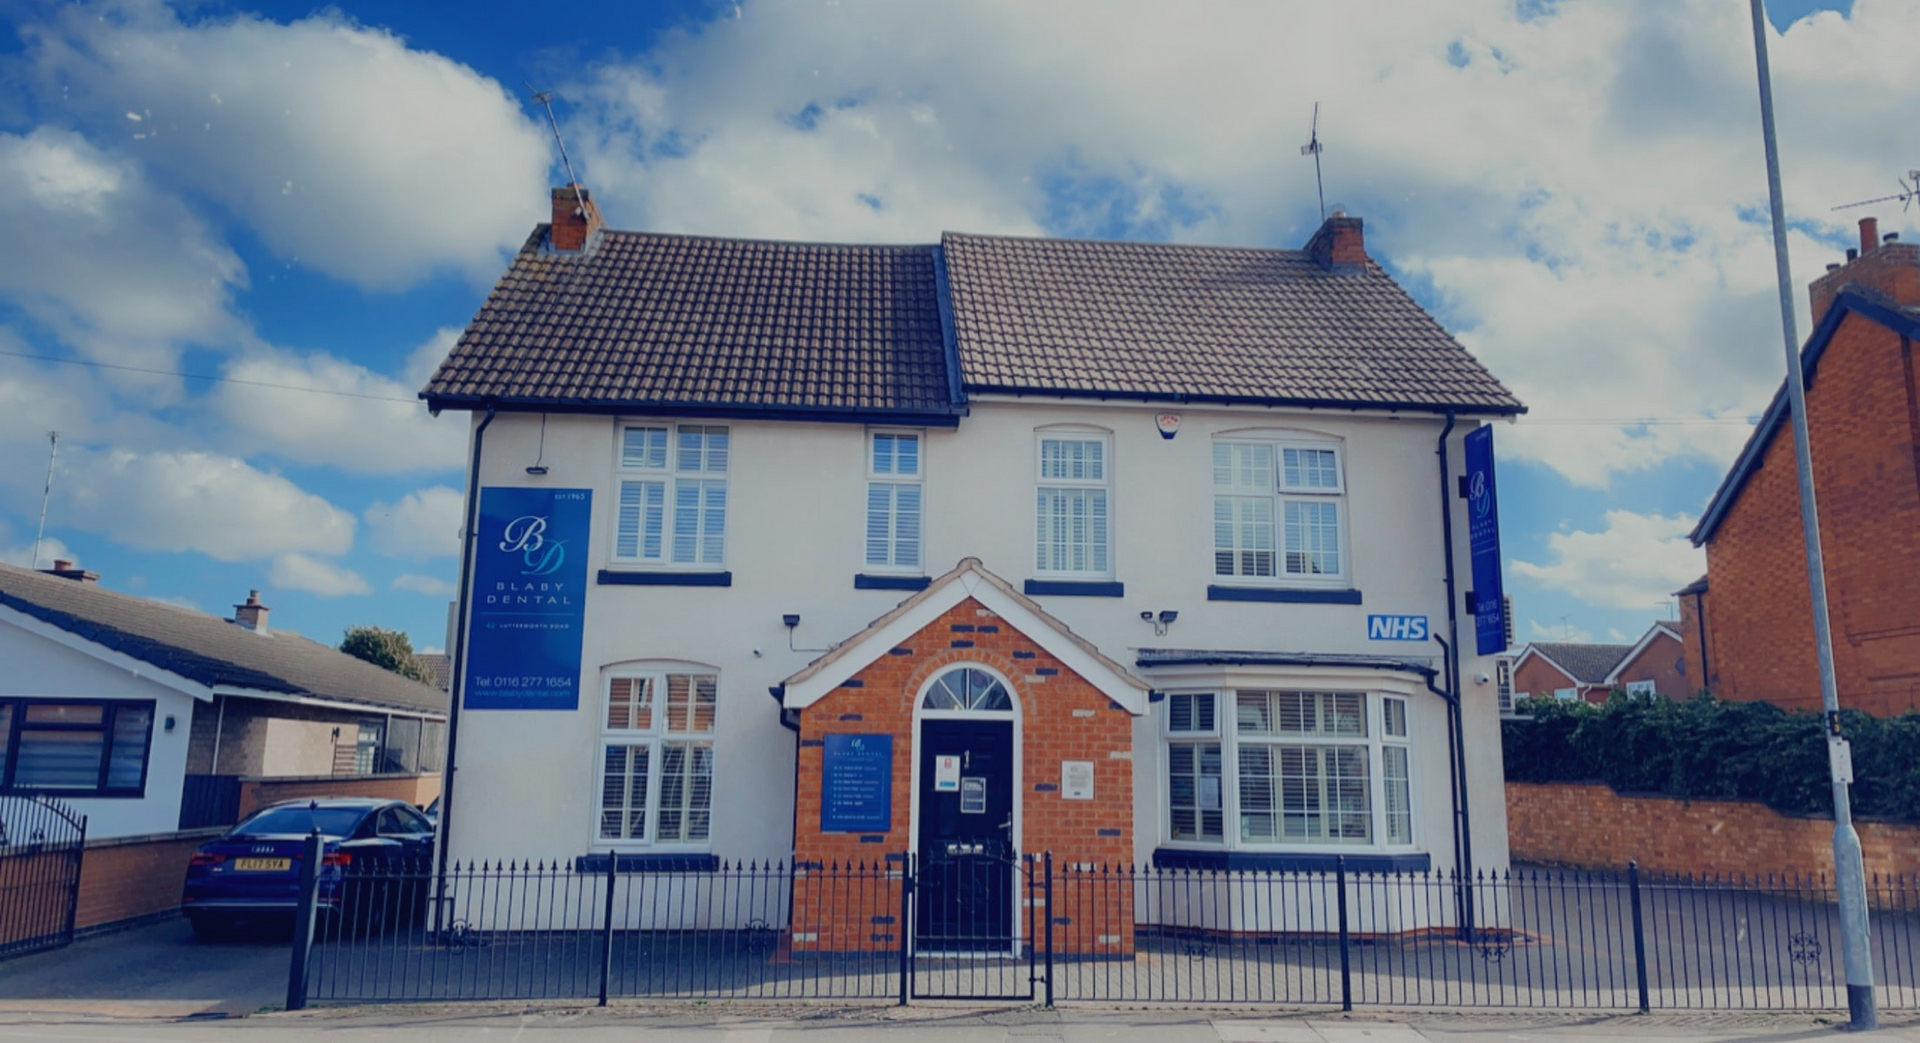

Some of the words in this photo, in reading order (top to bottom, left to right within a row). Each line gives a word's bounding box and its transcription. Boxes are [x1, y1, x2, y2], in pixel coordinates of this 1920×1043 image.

[496, 582, 564, 591] BLABY
[486, 595, 571, 605] DENTAL
[1370, 617, 1426, 639] NHS
[493, 676, 520, 687] 0116
[521, 676, 543, 687] 277
[546, 676, 572, 687] 1654
